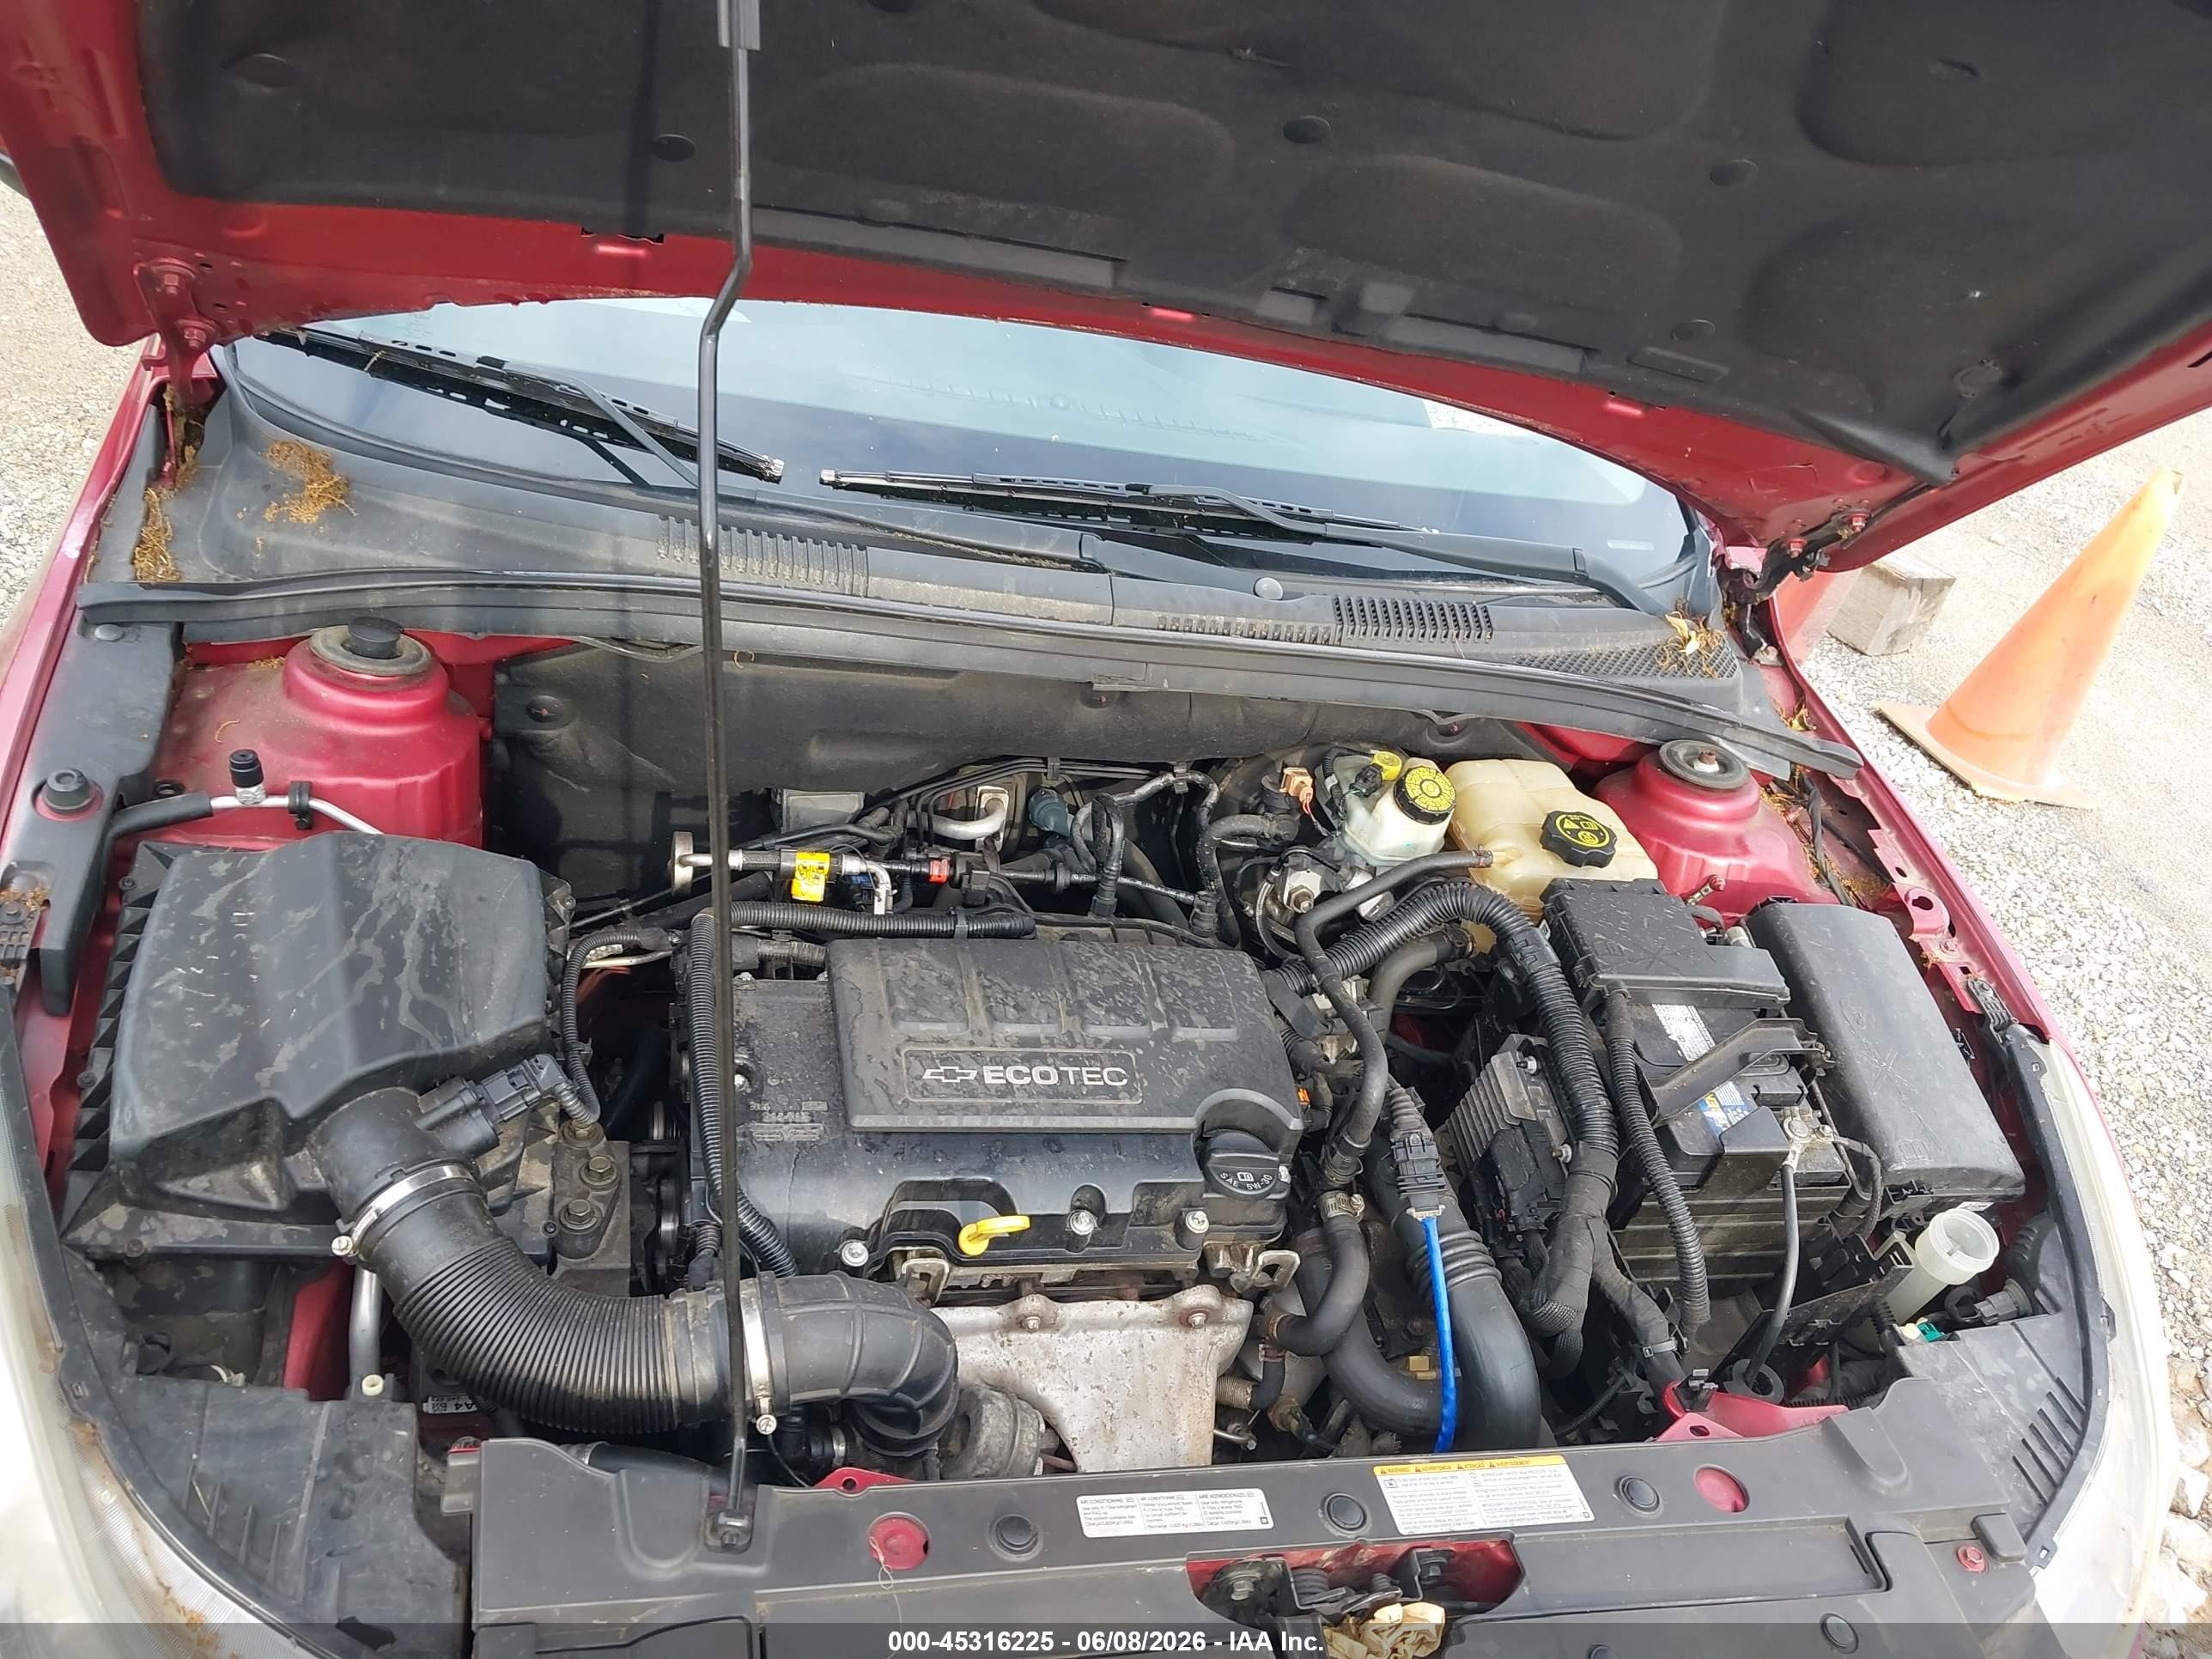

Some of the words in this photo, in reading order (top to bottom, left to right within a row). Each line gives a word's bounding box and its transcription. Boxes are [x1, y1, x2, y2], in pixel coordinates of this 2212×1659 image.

[982, 1065, 1128, 1086] ECOTEC
[1219, 1172, 1239, 1188] SAE
[1245, 1174, 1273, 1191] 5W-30
